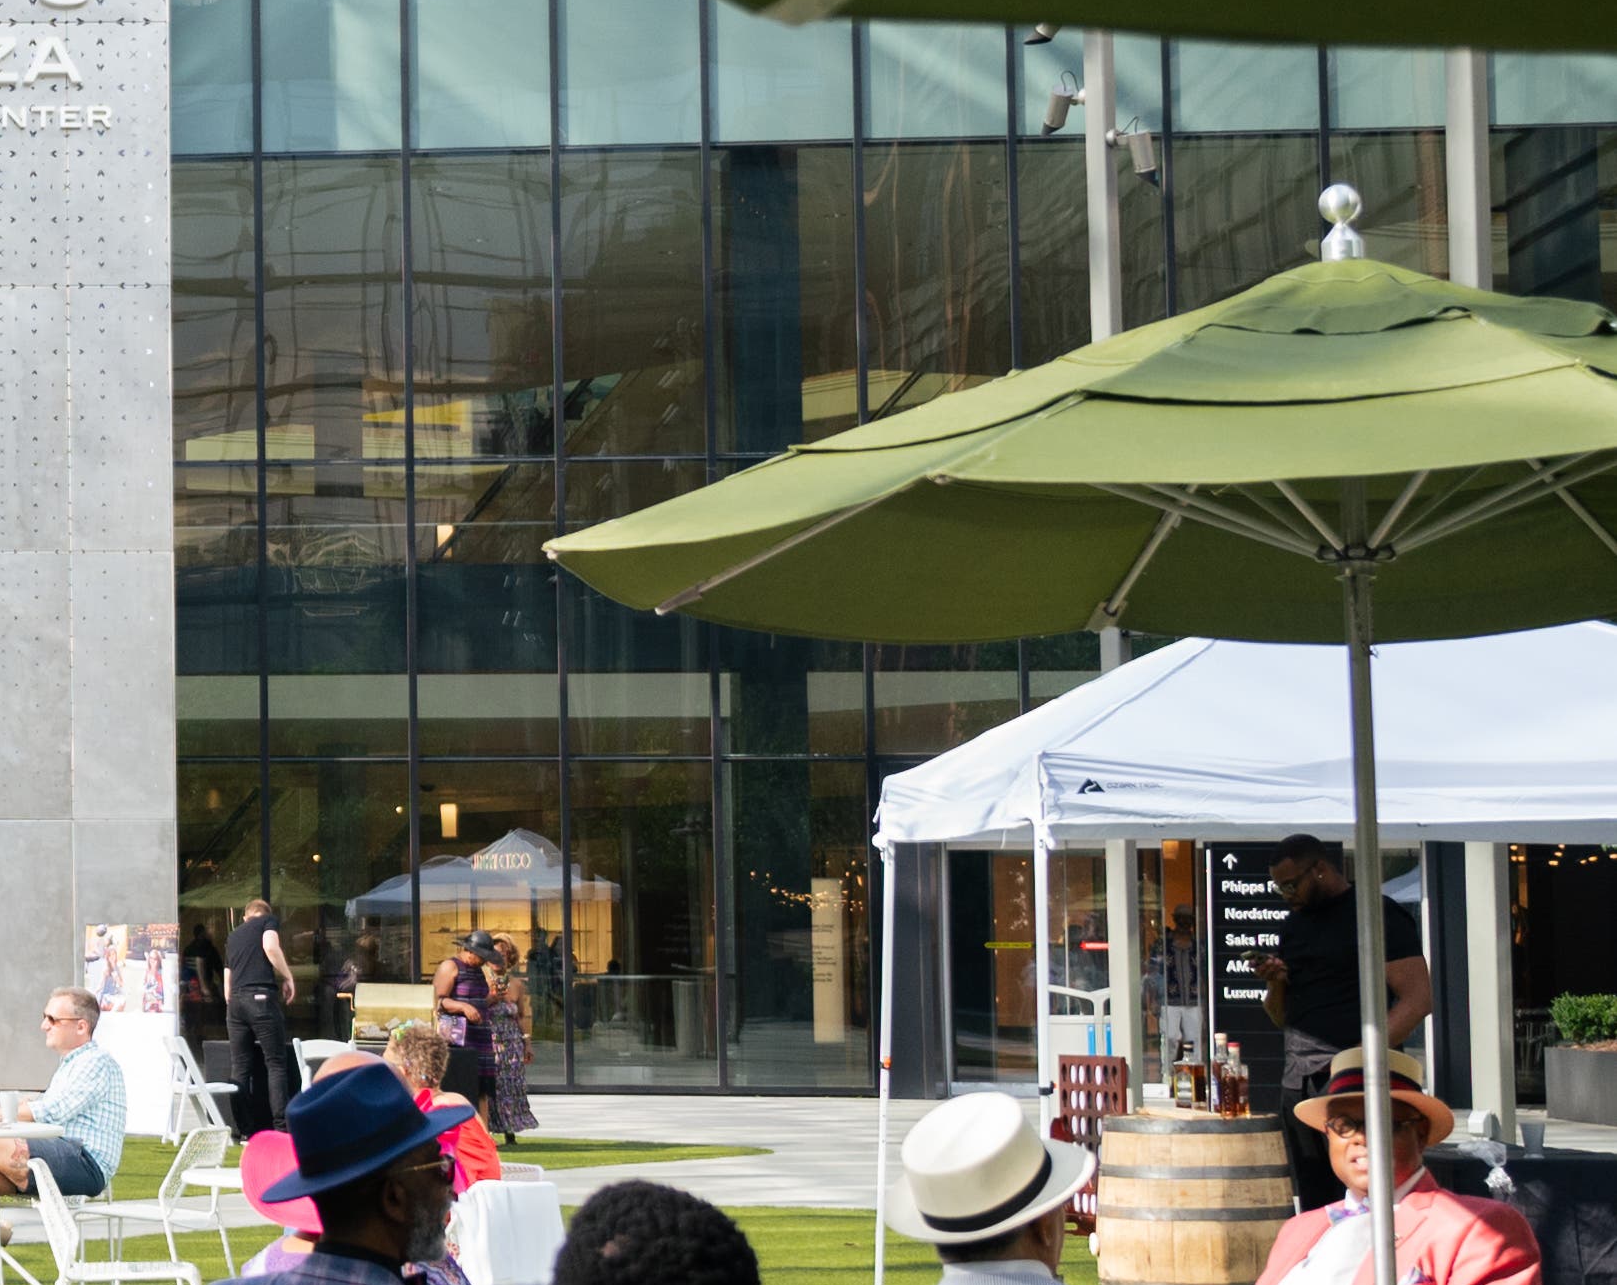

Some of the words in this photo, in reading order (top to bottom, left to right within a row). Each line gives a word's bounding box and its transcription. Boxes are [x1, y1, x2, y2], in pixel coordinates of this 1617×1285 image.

[1221, 880, 1265, 896] Phipps
[1225, 933, 1256, 946] Saks
[1226, 959, 1255, 973] AM
[1223, 986, 1268, 1002] Luxury
